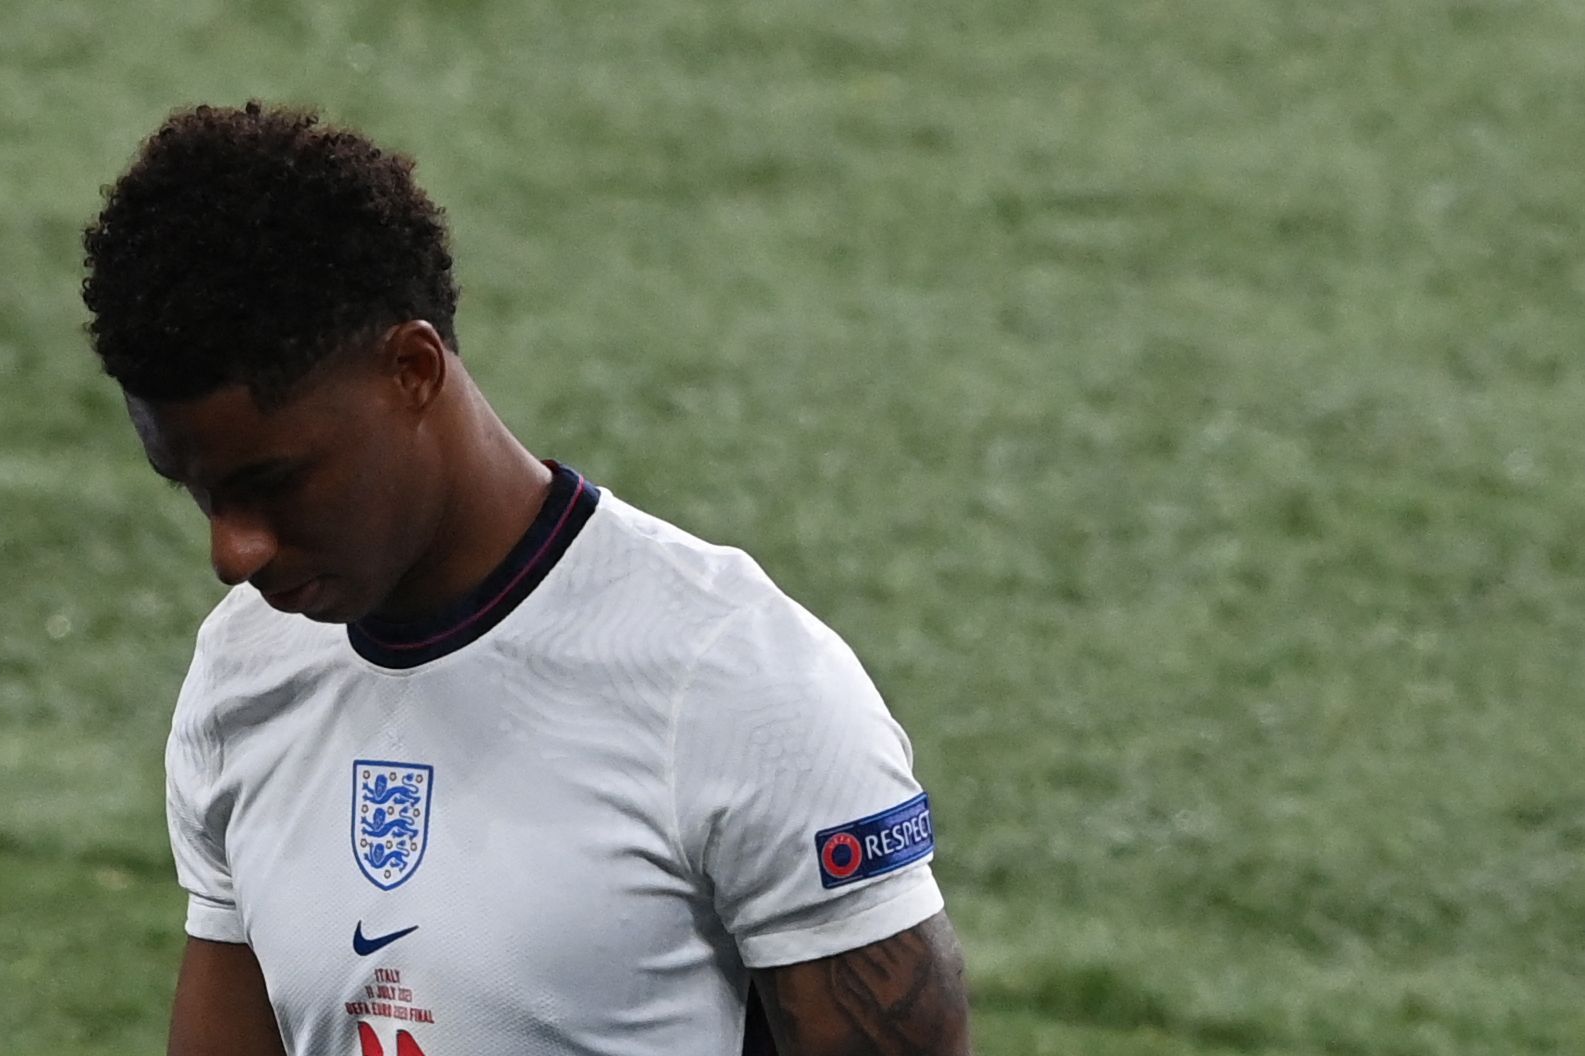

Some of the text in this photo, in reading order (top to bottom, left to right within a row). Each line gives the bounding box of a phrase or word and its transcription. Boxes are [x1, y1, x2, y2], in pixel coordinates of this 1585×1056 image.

[865, 810, 932, 860] RESPECT
[375, 968, 400, 983] ITALY
[377, 984, 396, 1000] JULY
[345, 1002, 371, 1016] UEFA
[410, 1008, 435, 1024] FINAL
